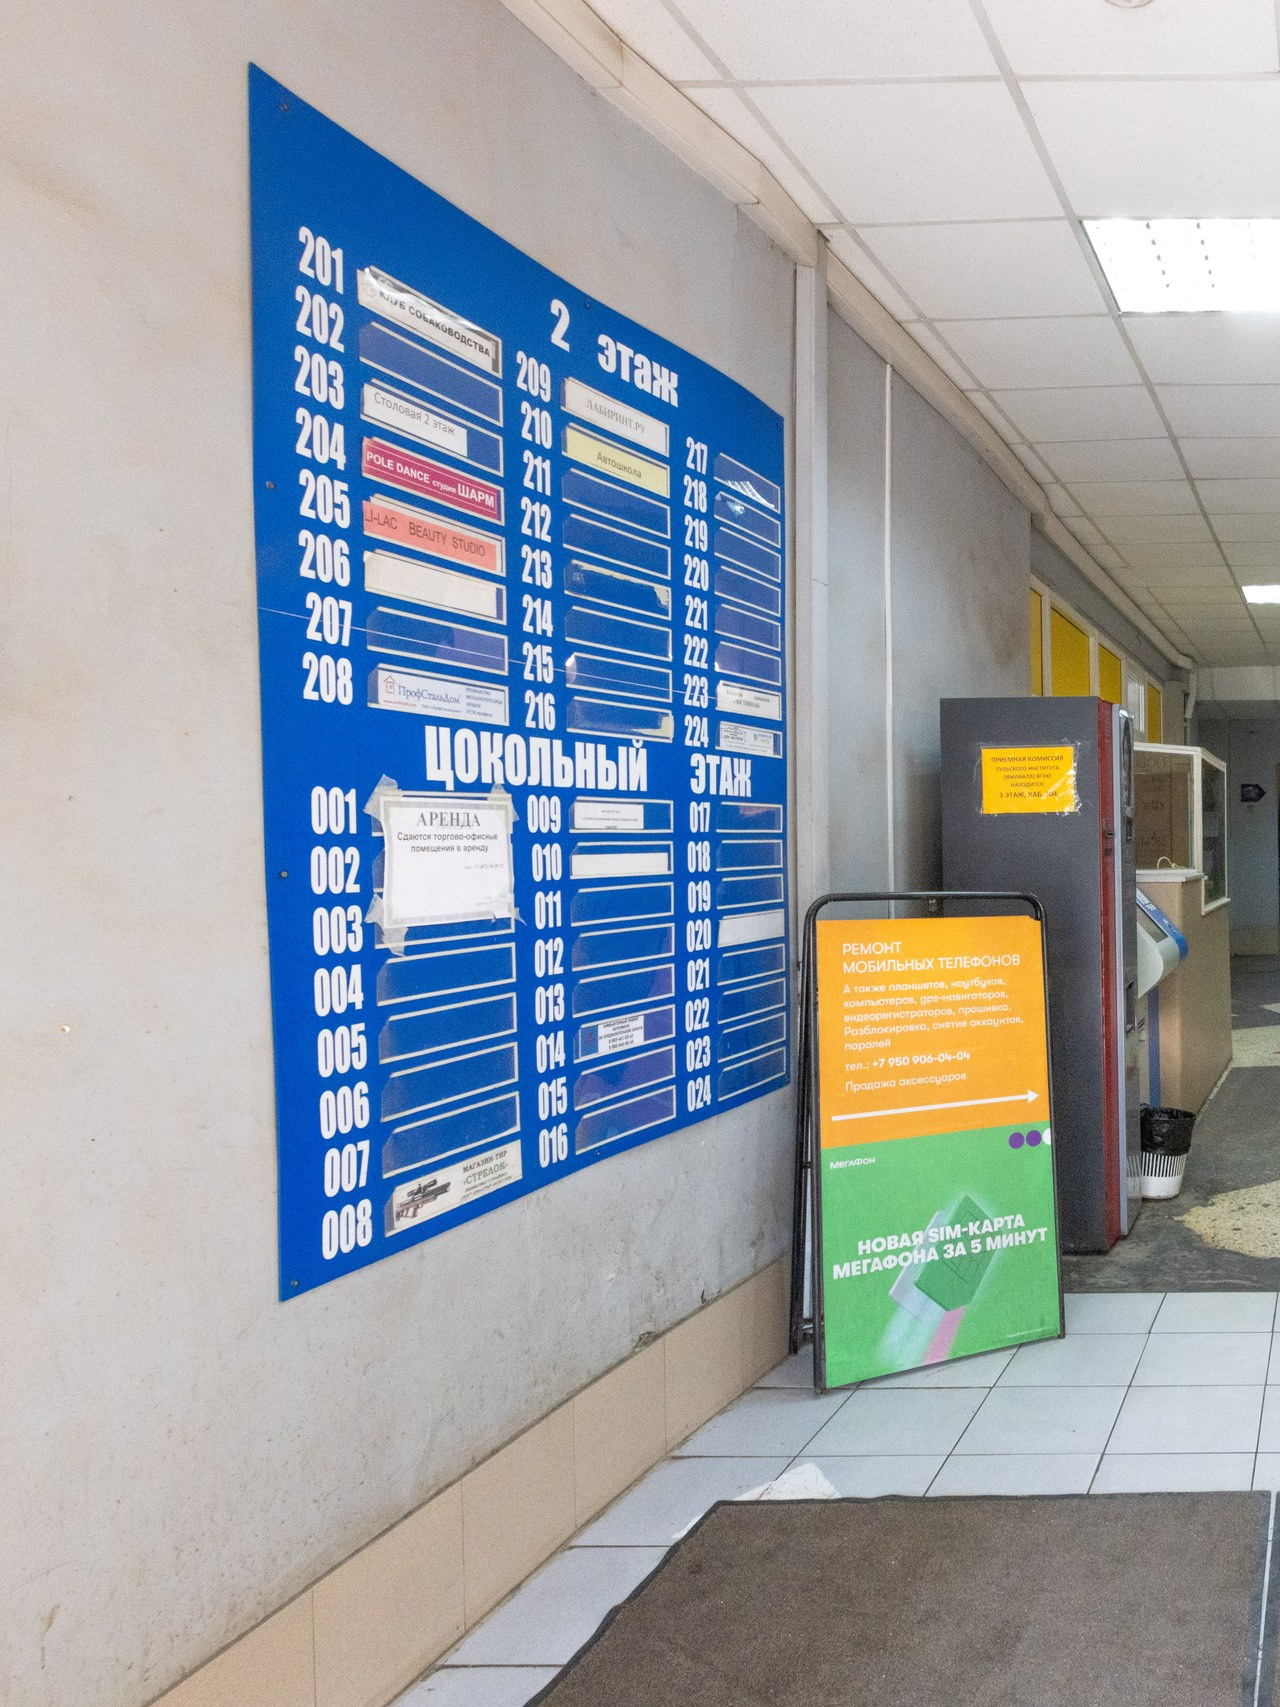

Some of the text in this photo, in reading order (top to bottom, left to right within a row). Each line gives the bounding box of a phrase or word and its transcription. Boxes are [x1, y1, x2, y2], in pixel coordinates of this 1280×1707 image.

[299, 226, 343, 294] 201
[295, 285, 344, 353] 202
[379, 290, 490, 358] КЛУБ СОБАКОВОДСТВА
[551, 299, 570, 352] 2
[294, 345, 344, 410] 203
[516, 350, 551, 403] 209
[374, 392, 455, 436] Столовая 2 этаж
[521, 400, 552, 449] 210
[586, 399, 646, 433] ЛАБИРИНТ.РУ
[295, 407, 346, 471] 204
[686, 436, 708, 475] 217
[366, 451, 394, 471] POLE
[396, 463, 430, 483] DANCE
[458, 483, 494, 508] ШАРМ
[522, 449, 551, 496] 211
[597, 452, 642, 478] Автошкола
[299, 468, 350, 529] 205
[683, 474, 707, 513] 218
[365, 509, 486, 557] LI-LAC BEAUTY STUDIO
[520, 496, 552, 543] 212
[684, 514, 708, 552] 219
[298, 529, 350, 587] 206
[521, 544, 553, 589] 213
[683, 553, 709, 592] 220
[305, 592, 352, 647] 207
[522, 594, 554, 638] 214
[685, 594, 708, 631] 221
[522, 641, 555, 684] 215
[683, 633, 709, 670] 222
[302, 652, 353, 705] 208
[683, 673, 709, 709] 223
[524, 689, 556, 731] 216
[684, 714, 709, 748] 224
[424, 725, 752, 797] ЦОКОЛЬНЫЙ ЭТАЖ
[311, 786, 357, 835] 001
[417, 812, 480, 828] АРЕНДА
[527, 794, 562, 834] 009
[689, 801, 711, 833] 017
[397, 832, 498, 844] Сдаются торгово-офисные
[411, 845, 454, 853] помещения
[463, 845, 489, 853] аренду
[687, 840, 711, 873] 018
[310, 846, 360, 895] 002
[531, 843, 563, 882] 010
[534, 890, 562, 930] 011
[687, 880, 711, 913] 019
[313, 905, 363, 956] 003
[686, 918, 712, 953] 020
[842, 941, 902, 955] РЕМОНТ
[534, 937, 564, 978] 012
[687, 957, 710, 993] 021
[843, 954, 1020, 974] МОБИЛЬНЫХ ТЕЛЕФОНОВ
[314, 964, 364, 1017] 004
[535, 983, 565, 1025] 013
[844, 976, 1006, 994] А также планшетов, ноутбуков,
[844, 990, 1008, 1008] компьютеров, gps-навигаторов,
[685, 997, 710, 1033] 022
[844, 1006, 956, 1022] видеорегистраторов,
[844, 1015, 1024, 1037] Разблокировка, снятие аккаунтов,
[317, 1022, 367, 1078] 005
[535, 1030, 566, 1074] 014
[686, 1035, 711, 1073] 023
[844, 1038, 891, 1051] паролей
[872, 1058, 885, 1069] +7
[887, 1055, 910, 1068] 950
[912, 1051, 971, 1066] 906-04-04
[538, 1076, 568, 1121] 015
[687, 1074, 712, 1112] 024
[845, 1071, 967, 1093] Продажа аксессуаров
[319, 1081, 370, 1140] 006
[463, 1150, 507, 1173] МАГАЗИН-ТИР
[538, 1122, 568, 1168] 016
[324, 1139, 370, 1198] 007
[321, 1198, 372, 1260] 008
[857, 1214, 1026, 1256] НОВАЯ SIM-КАРТА
[832, 1227, 1048, 1280] МЕГАФОНА ЗА 5 МИНУТ
